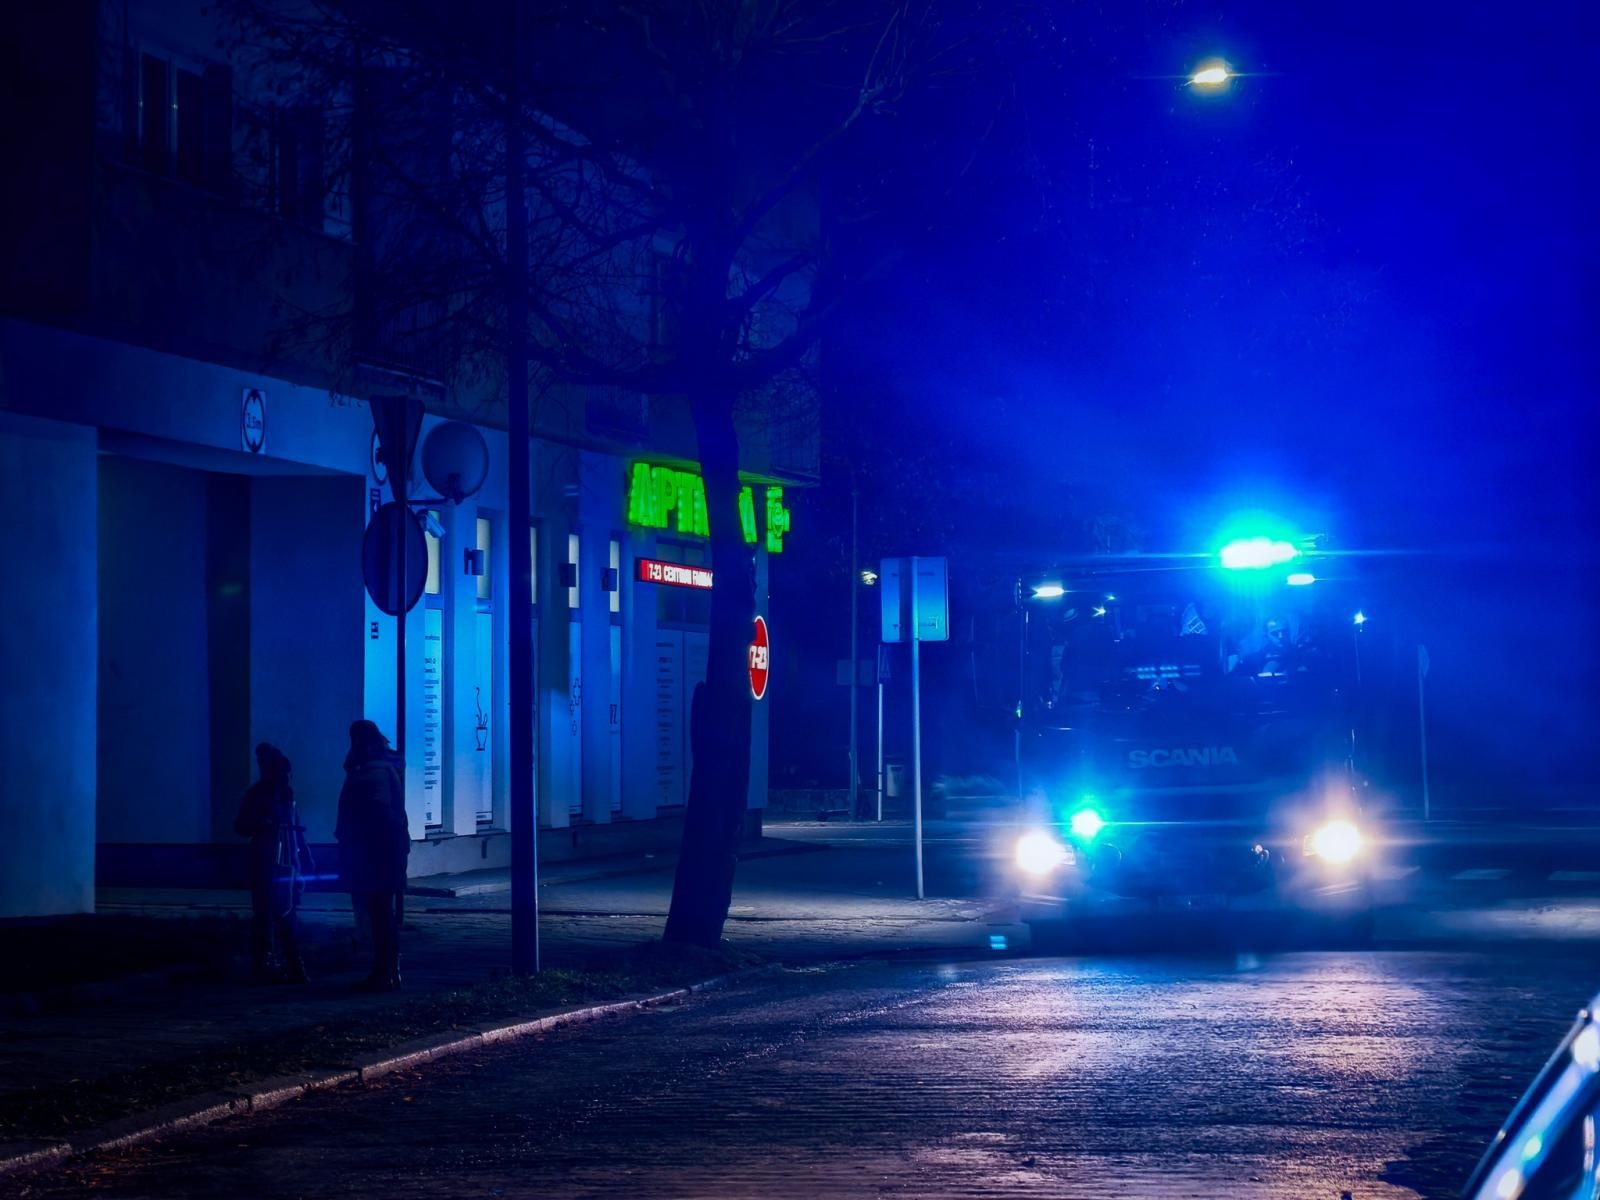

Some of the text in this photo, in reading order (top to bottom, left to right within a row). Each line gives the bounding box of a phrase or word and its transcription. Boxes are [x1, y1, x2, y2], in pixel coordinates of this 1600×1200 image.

[649, 563, 662, 580] 7-23
[751, 645, 767, 670] 7-23
[1128, 746, 1239, 769] SCANIA
